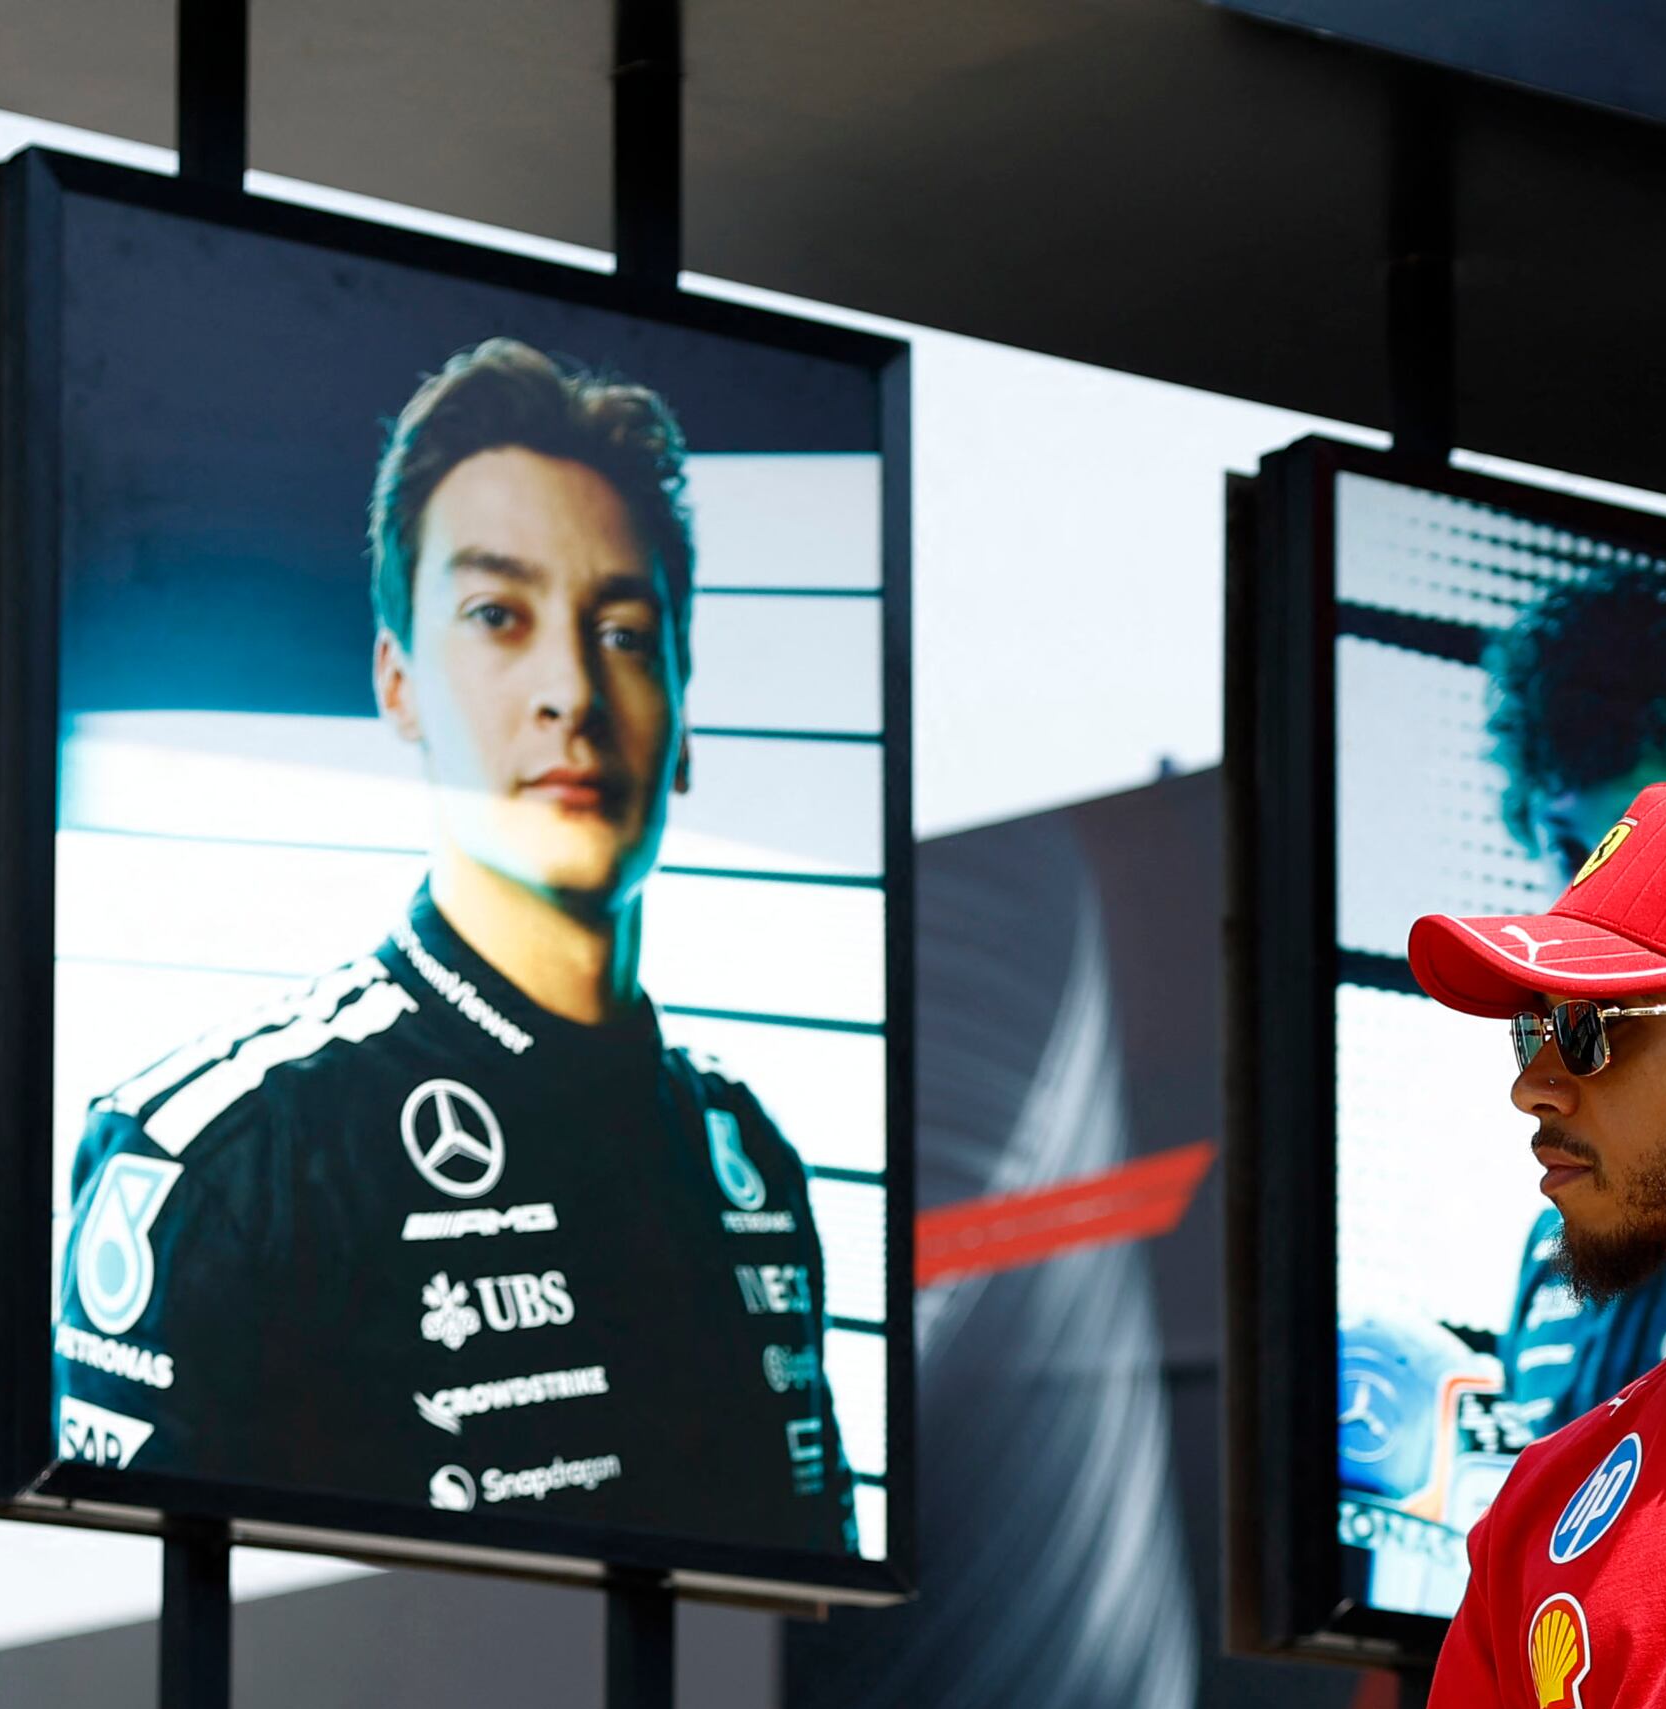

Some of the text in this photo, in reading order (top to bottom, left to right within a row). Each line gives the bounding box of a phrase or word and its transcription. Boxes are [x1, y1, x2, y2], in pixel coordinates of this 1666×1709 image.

[473, 1270, 576, 1333] UBS
[480, 1454, 622, 1503] Snapdragon
[1557, 1442, 1633, 1557] hp
